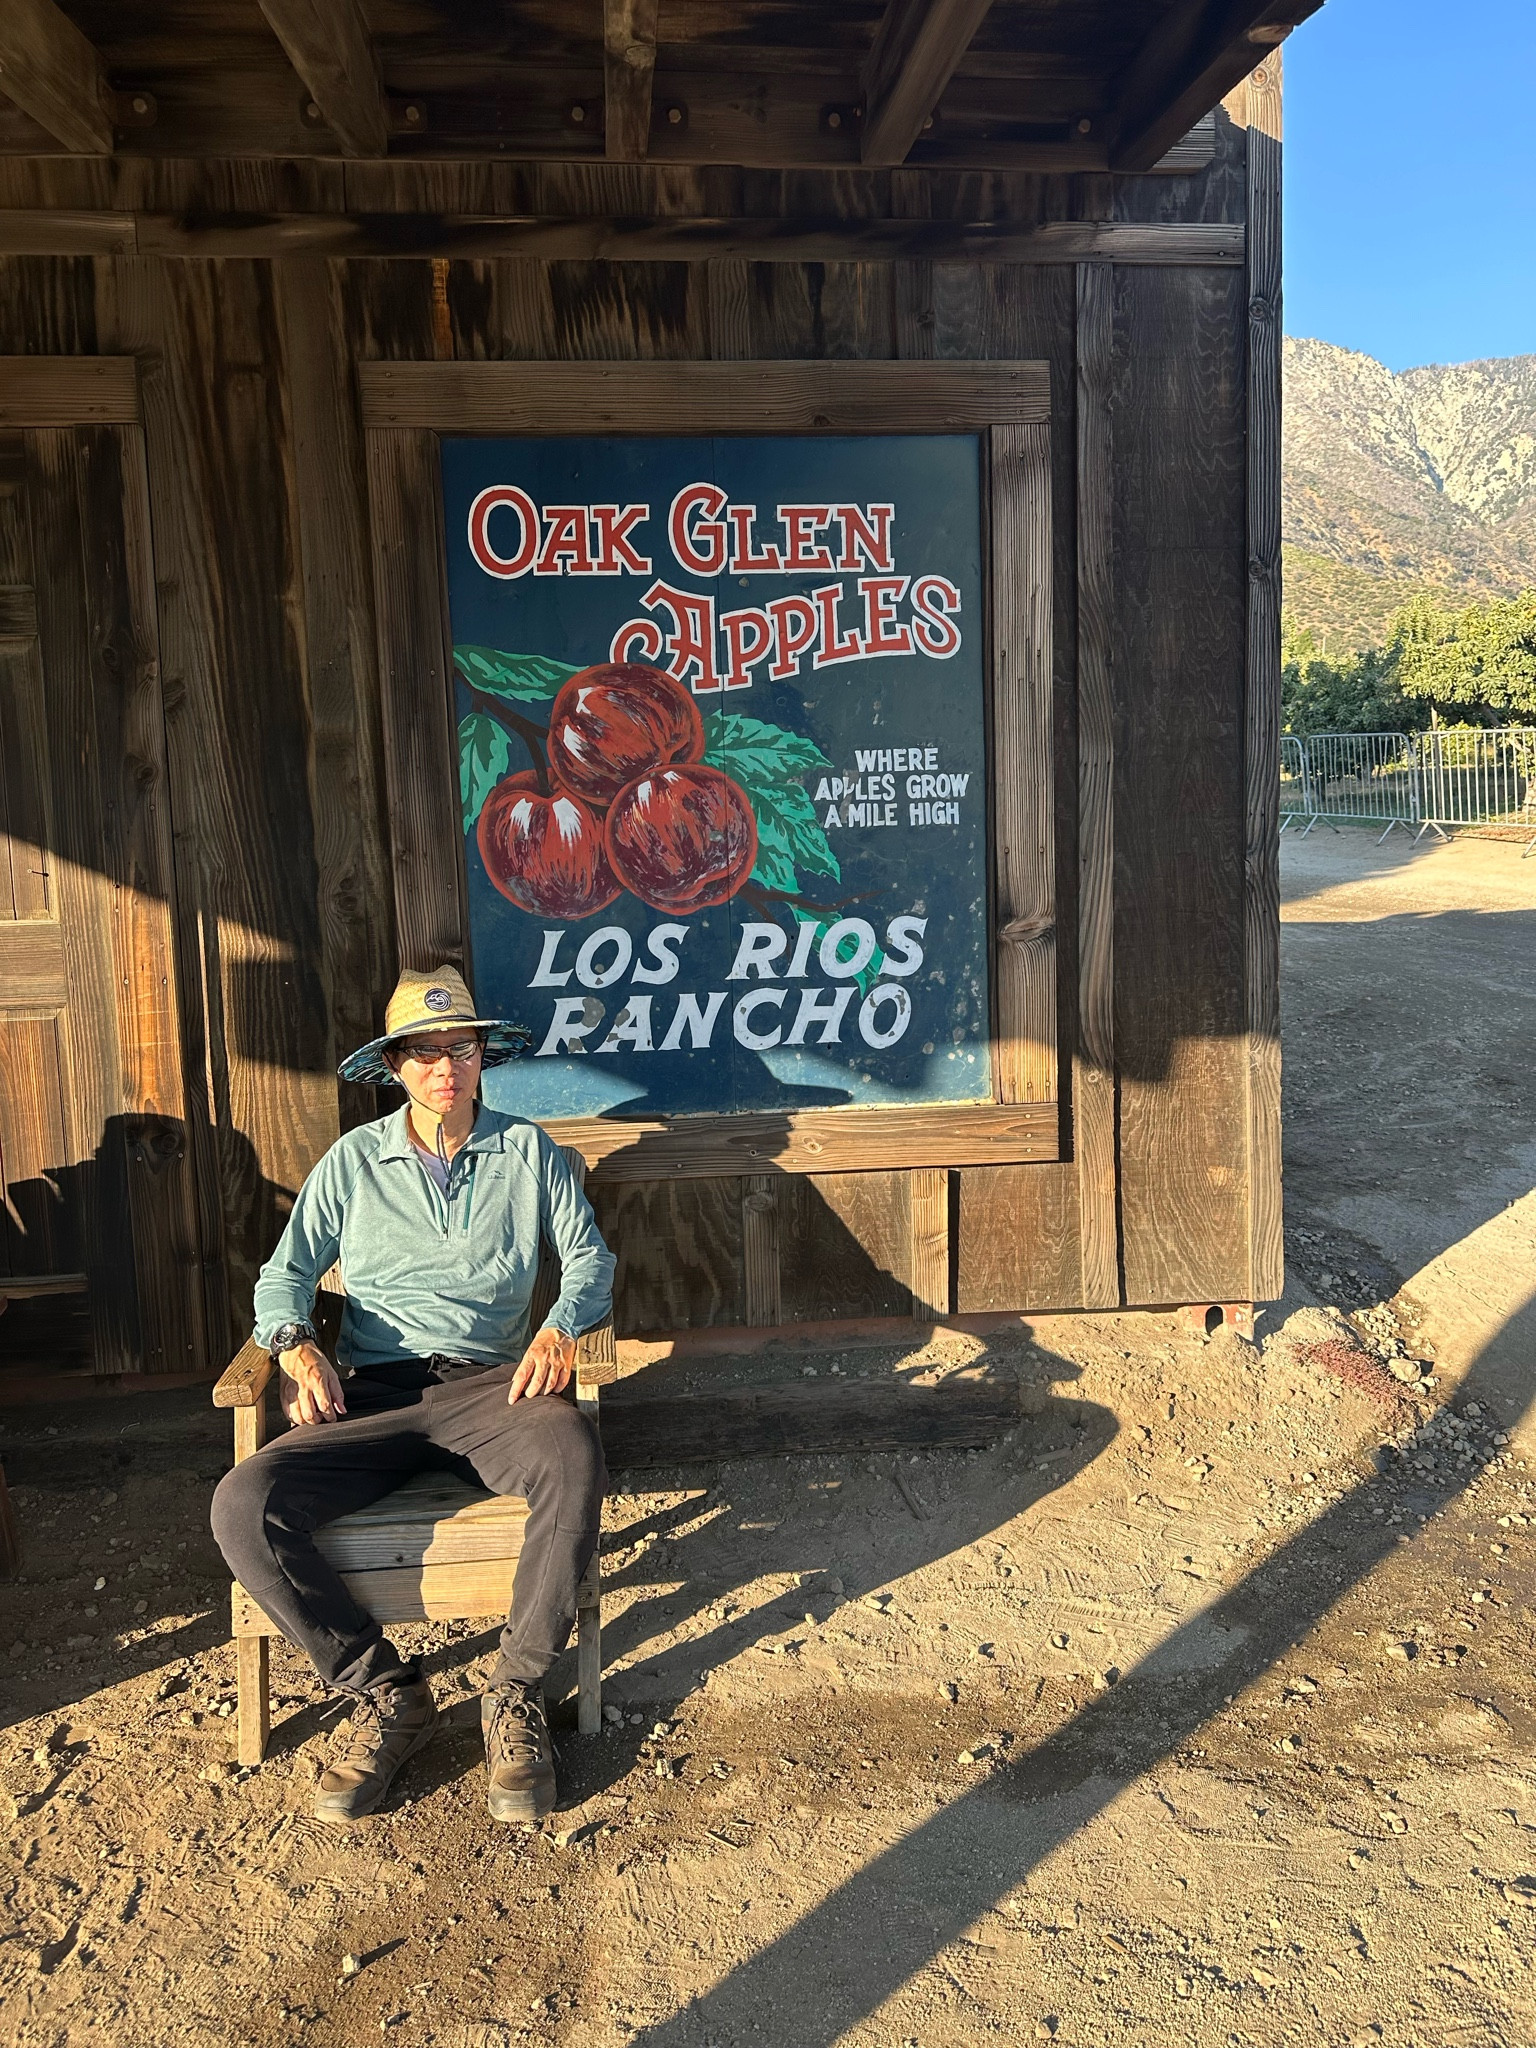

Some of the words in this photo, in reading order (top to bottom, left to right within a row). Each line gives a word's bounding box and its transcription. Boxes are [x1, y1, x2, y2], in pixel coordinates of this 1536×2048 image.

[468, 485, 652, 579] OAK
[668, 482, 895, 577] GLEN
[610, 575, 961, 694] APPLES
[855, 748, 938, 772] WHERE
[906, 773, 970, 799] GROW
[824, 804, 842, 828] A
[848, 803, 898, 827] MILE
[909, 802, 960, 826] HIGH
[527, 923, 690, 988] LOS
[725, 916, 929, 980] RIOS
[534, 983, 912, 1057] RANCHO
